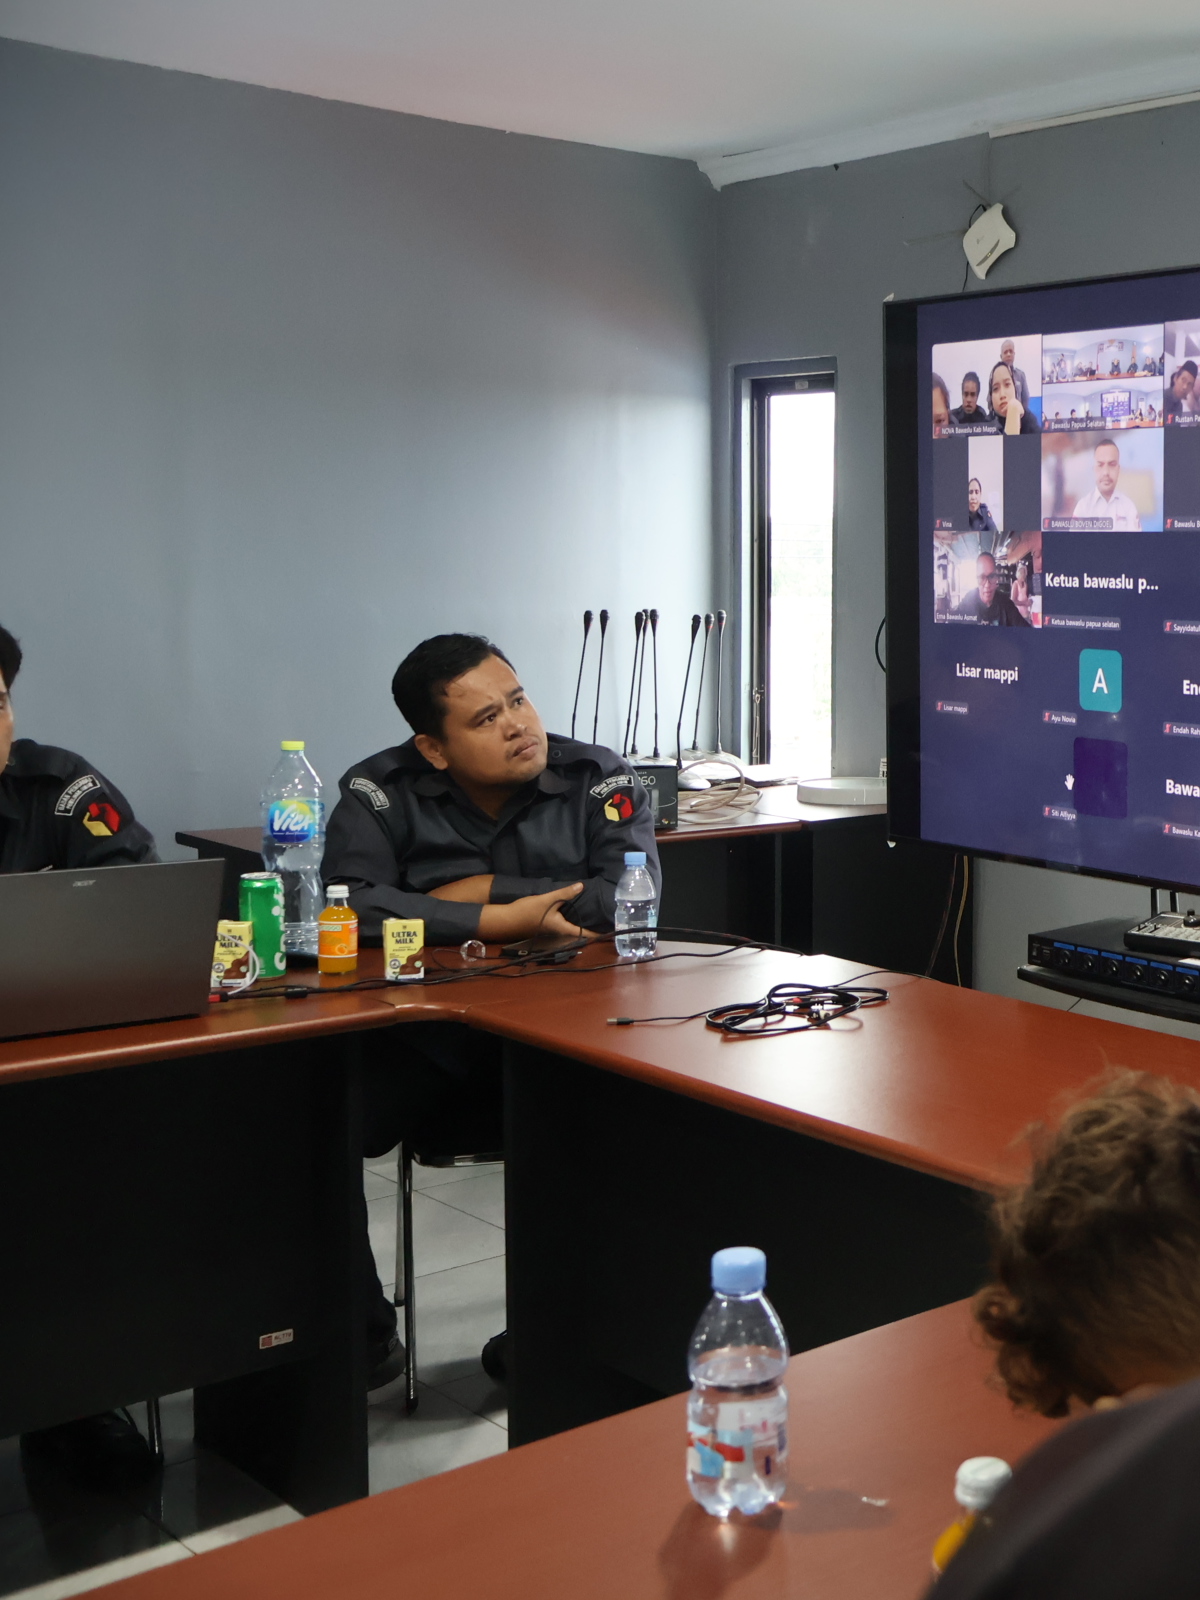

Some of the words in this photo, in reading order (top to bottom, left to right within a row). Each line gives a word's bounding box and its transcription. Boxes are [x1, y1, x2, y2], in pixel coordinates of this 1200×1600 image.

[1074, 520, 1093, 528] BOVEN
[1174, 520, 1196, 528] Bawaslu
[1045, 572, 1080, 588] Ketua
[1083, 573, 1134, 590] bawaslu
[1138, 577, 1159, 594] p...
[1051, 618, 1066, 626] Ketua
[1066, 618, 1086, 627] bawaslu
[1086, 620, 1101, 629] papua
[1102, 620, 1120, 629] selatan
[1173, 624, 1200, 634] Sayyidatul
[956, 662, 982, 679] Lisar
[984, 666, 1019, 684] mappi
[1092, 668, 1108, 694] A
[943, 704, 954, 712] Lisar
[954, 704, 968, 714] mappi
[1051, 714, 1062, 724] Ayu
[1062, 715, 1076, 724] Novia
[1172, 725, 1190, 734] Endah
[1172, 826, 1194, 836] Bawaslu
[392, 930, 418, 938] ULTRA
